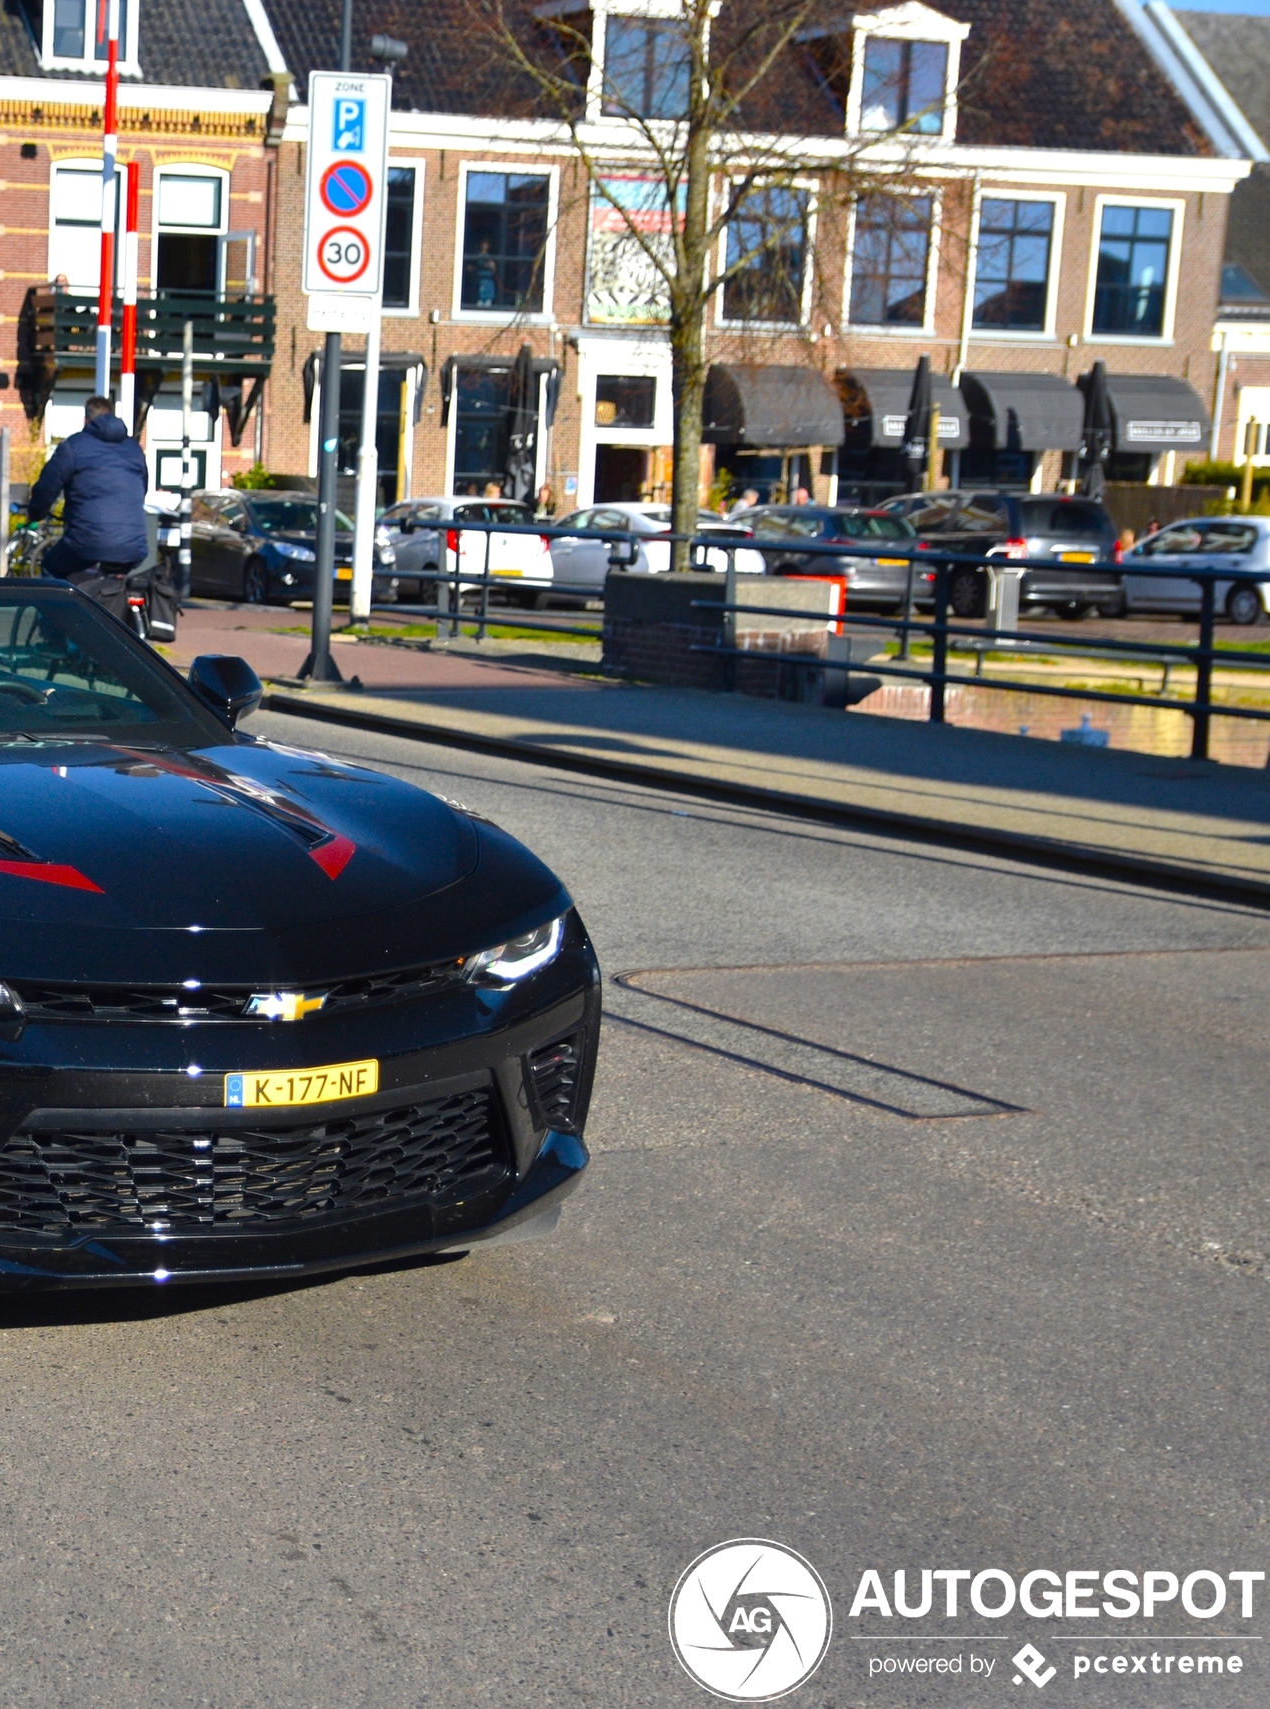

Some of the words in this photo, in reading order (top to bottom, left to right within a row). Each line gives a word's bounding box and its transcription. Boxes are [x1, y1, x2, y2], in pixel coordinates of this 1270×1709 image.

[335, 82, 365, 93] ZONE
[338, 101, 360, 131] P
[327, 242, 361, 265] 30
[255, 1068, 368, 1104] K-177-NF
[229, 1095, 241, 1104] NL
